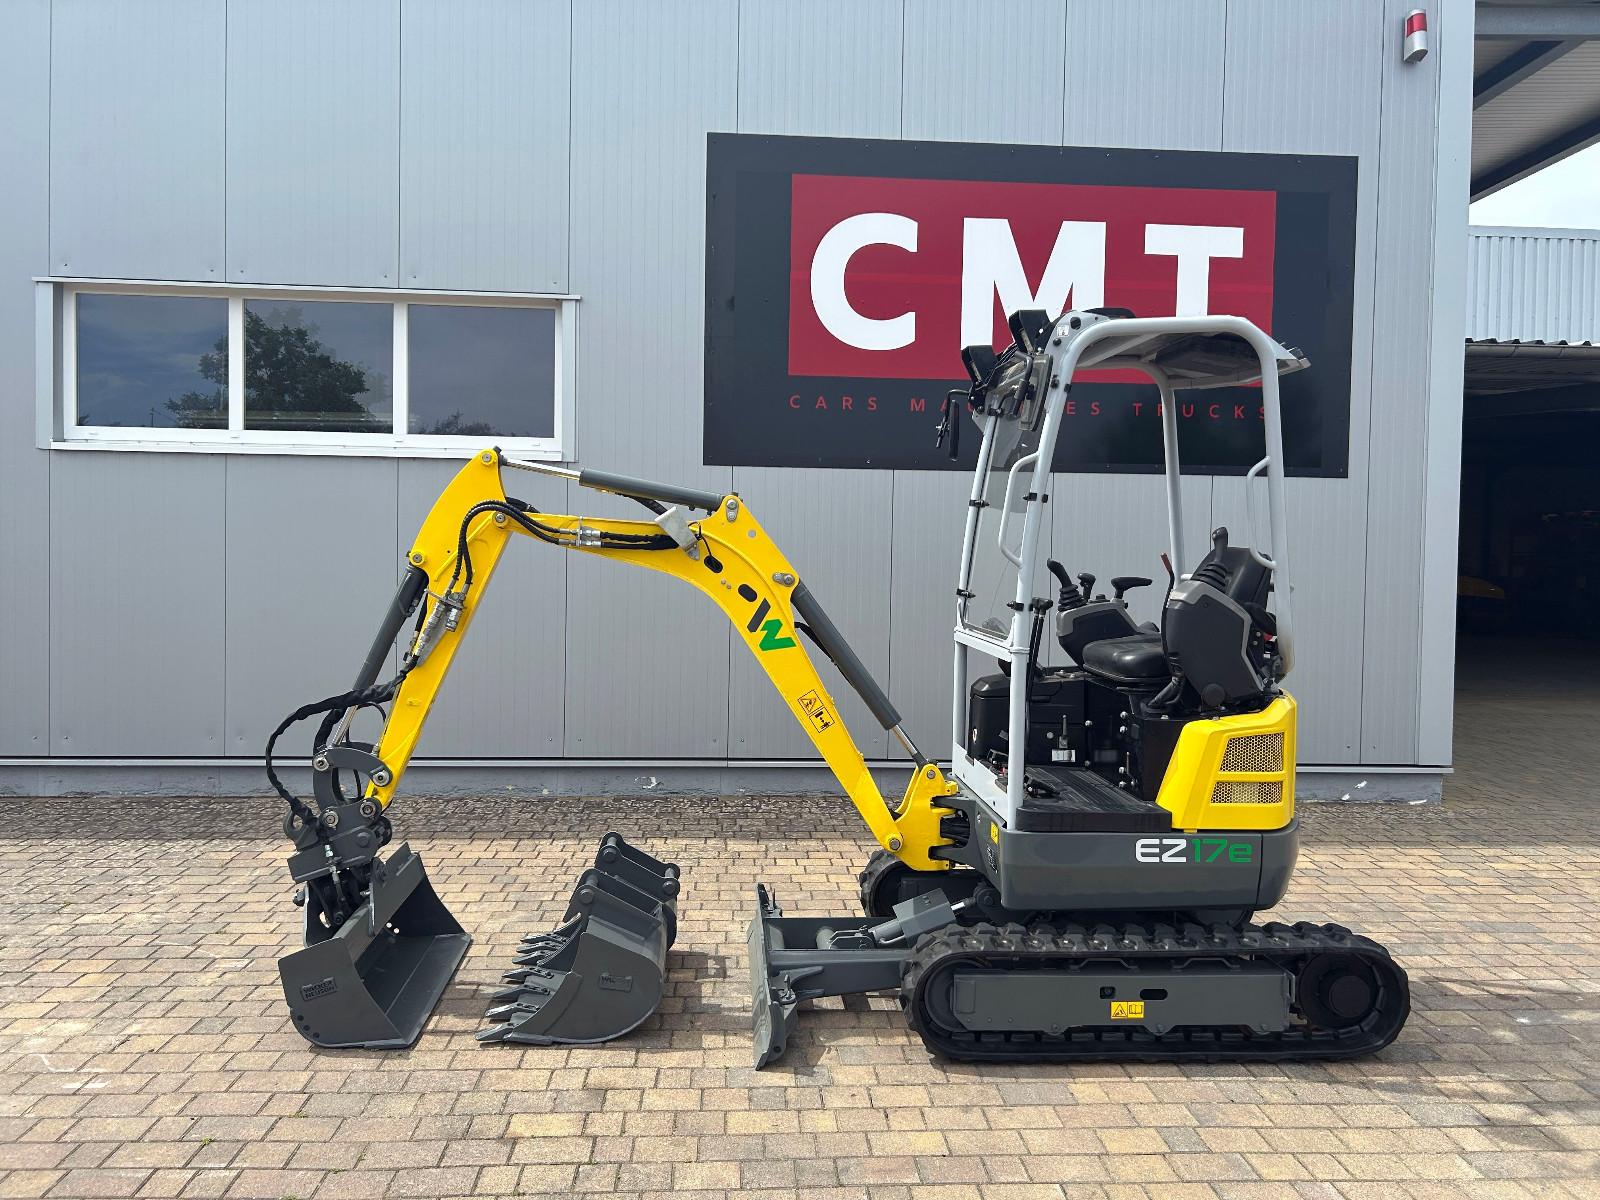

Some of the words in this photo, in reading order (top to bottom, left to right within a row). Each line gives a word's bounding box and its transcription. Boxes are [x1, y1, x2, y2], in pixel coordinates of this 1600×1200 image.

[810, 212, 1244, 351] CMT
[789, 395, 878, 411] CARS
[1135, 838, 1253, 863] EZ17e
